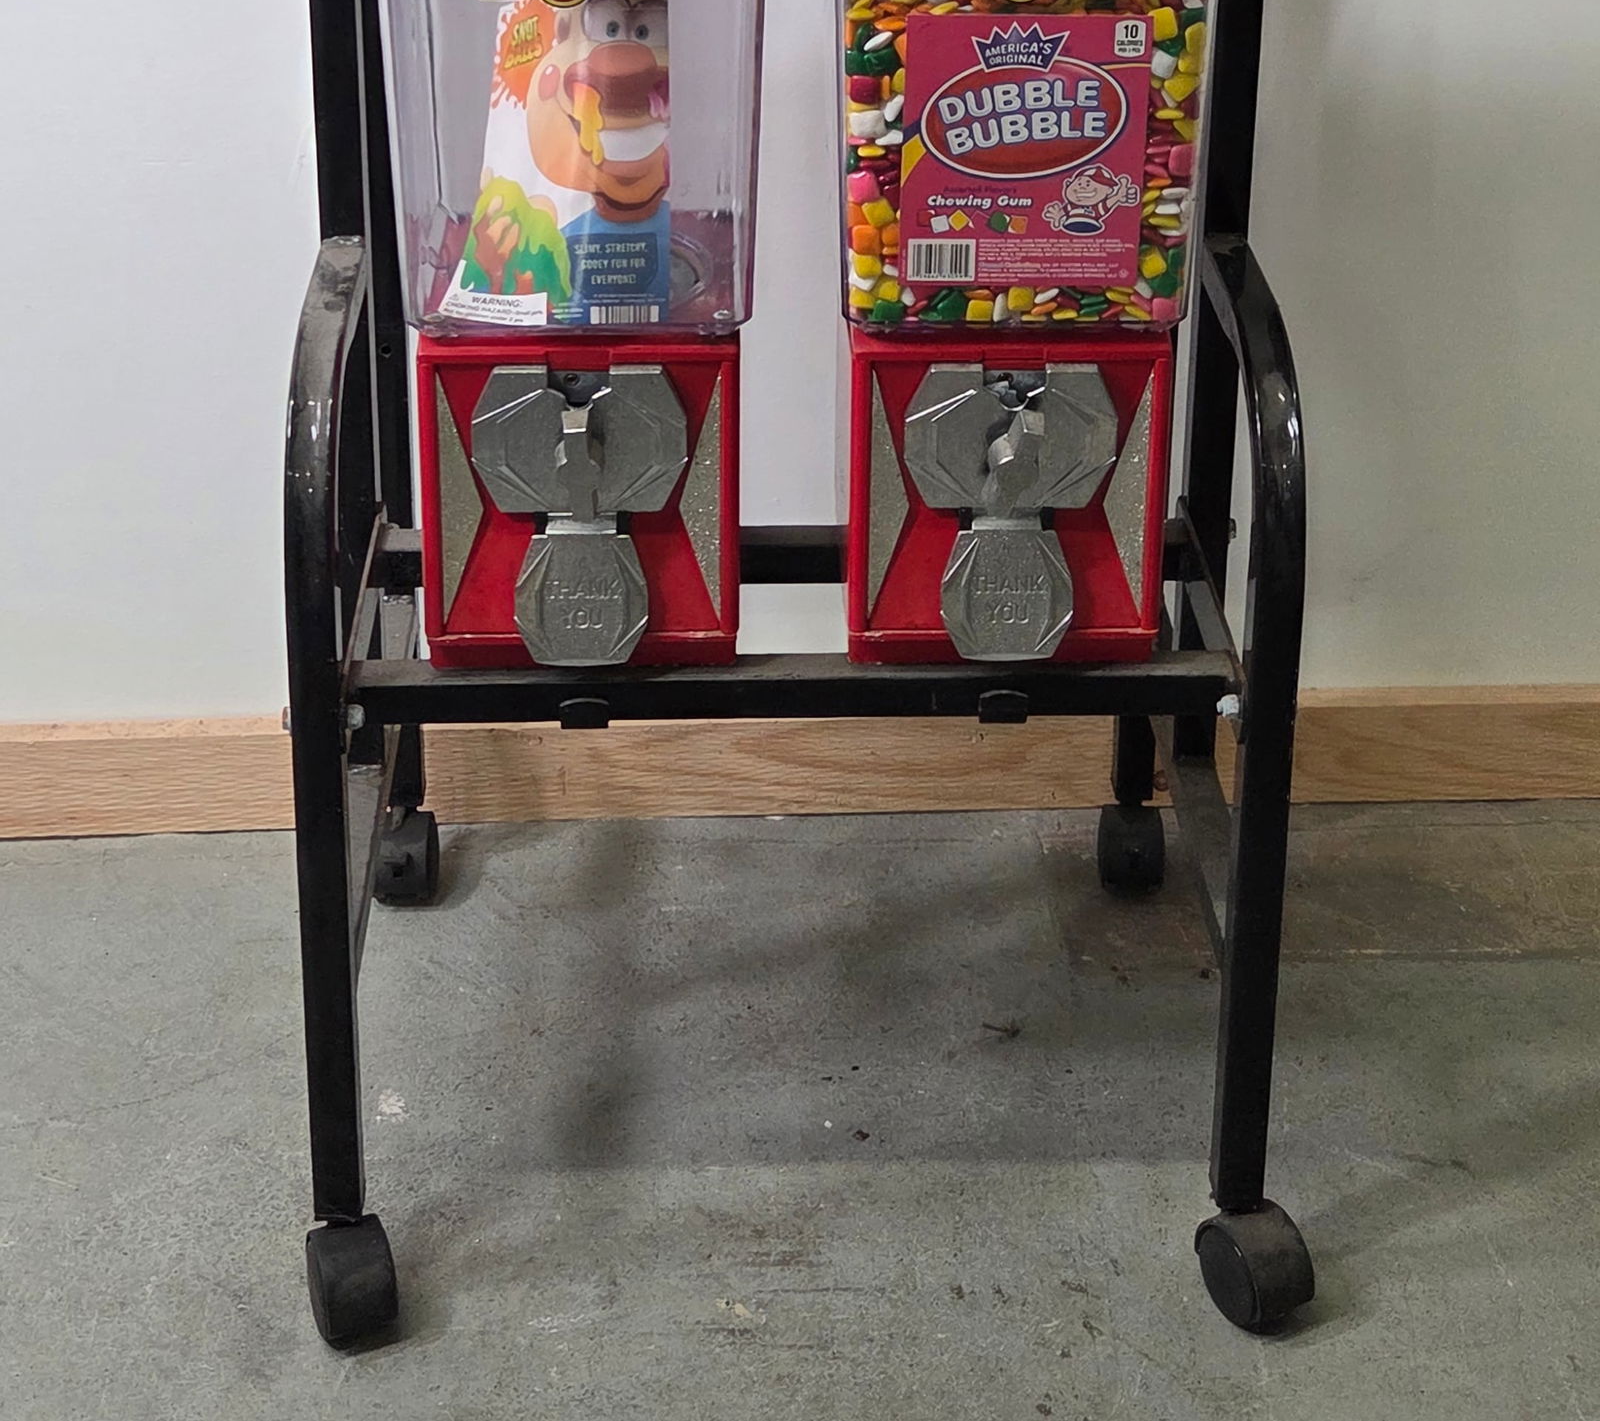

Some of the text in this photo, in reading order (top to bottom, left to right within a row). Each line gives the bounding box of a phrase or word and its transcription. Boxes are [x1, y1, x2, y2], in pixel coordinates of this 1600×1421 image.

[511, 15, 540, 46] SNOT
[1123, 24, 1139, 39] 10
[984, 41, 1053, 57] AMERICA'S
[989, 54, 1044, 66] ORIGINAL
[938, 80, 1101, 124] DUBBLE
[945, 110, 1107, 156] BUBBLE
[927, 194, 1032, 209] Chewing Gum
[611, 258, 628, 269] FUN
[630, 257, 646, 269] FOR
[471, 296, 523, 308] WARNING:
[545, 579, 624, 600] THANK
[972, 575, 1049, 595] THANK
[562, 607, 604, 629] YOU
[989, 602, 1030, 624] YOU
